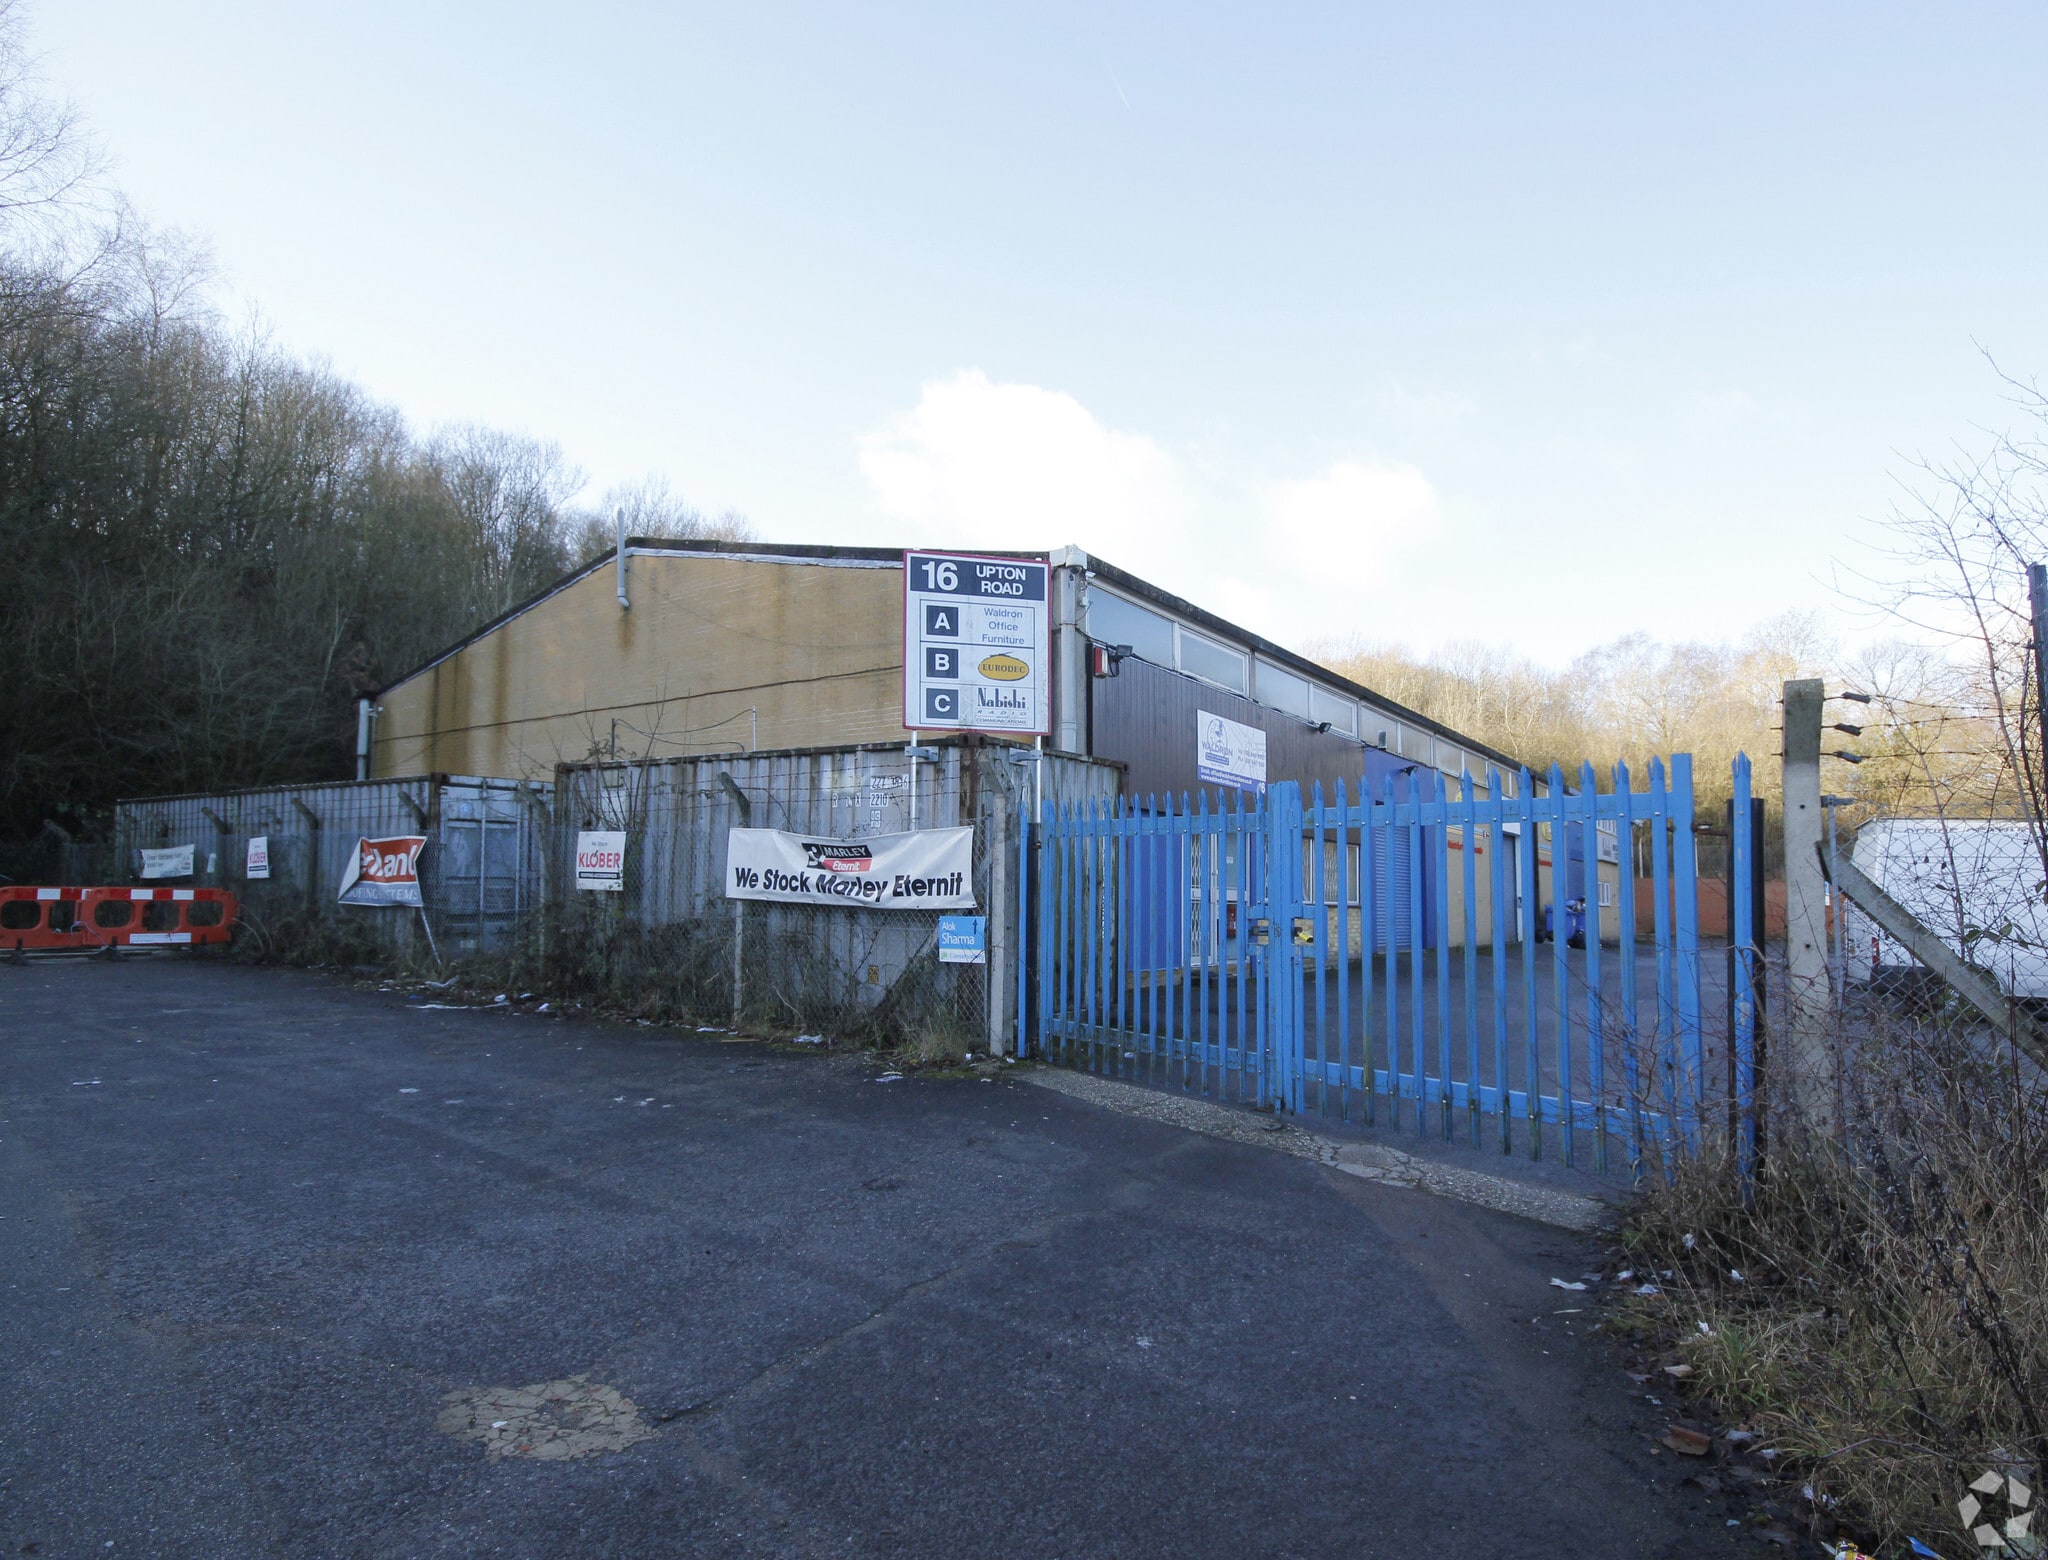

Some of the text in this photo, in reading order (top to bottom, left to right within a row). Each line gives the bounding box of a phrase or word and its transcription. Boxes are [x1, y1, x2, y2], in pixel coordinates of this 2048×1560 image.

[922, 561, 959, 591] 16
[976, 565, 1026, 581] UPTON
[981, 580, 1023, 596] ROAD
[984, 607, 1023, 619] Waldron
[934, 612, 950, 630] A
[988, 622, 1018, 632] Office
[982, 634, 1025, 645] Furniture
[934, 653, 950, 671] B
[982, 662, 1025, 674] EURODEC
[934, 694, 951, 713] C
[977, 687, 1026, 709] Nabishi
[823, 847, 867, 858] MARLEY
[832, 860, 861, 872] Eternit
[735, 867, 963, 903] We Stock Marley Eternit
[941, 921, 956, 931] Alok
[941, 932, 975, 945] Sharma
